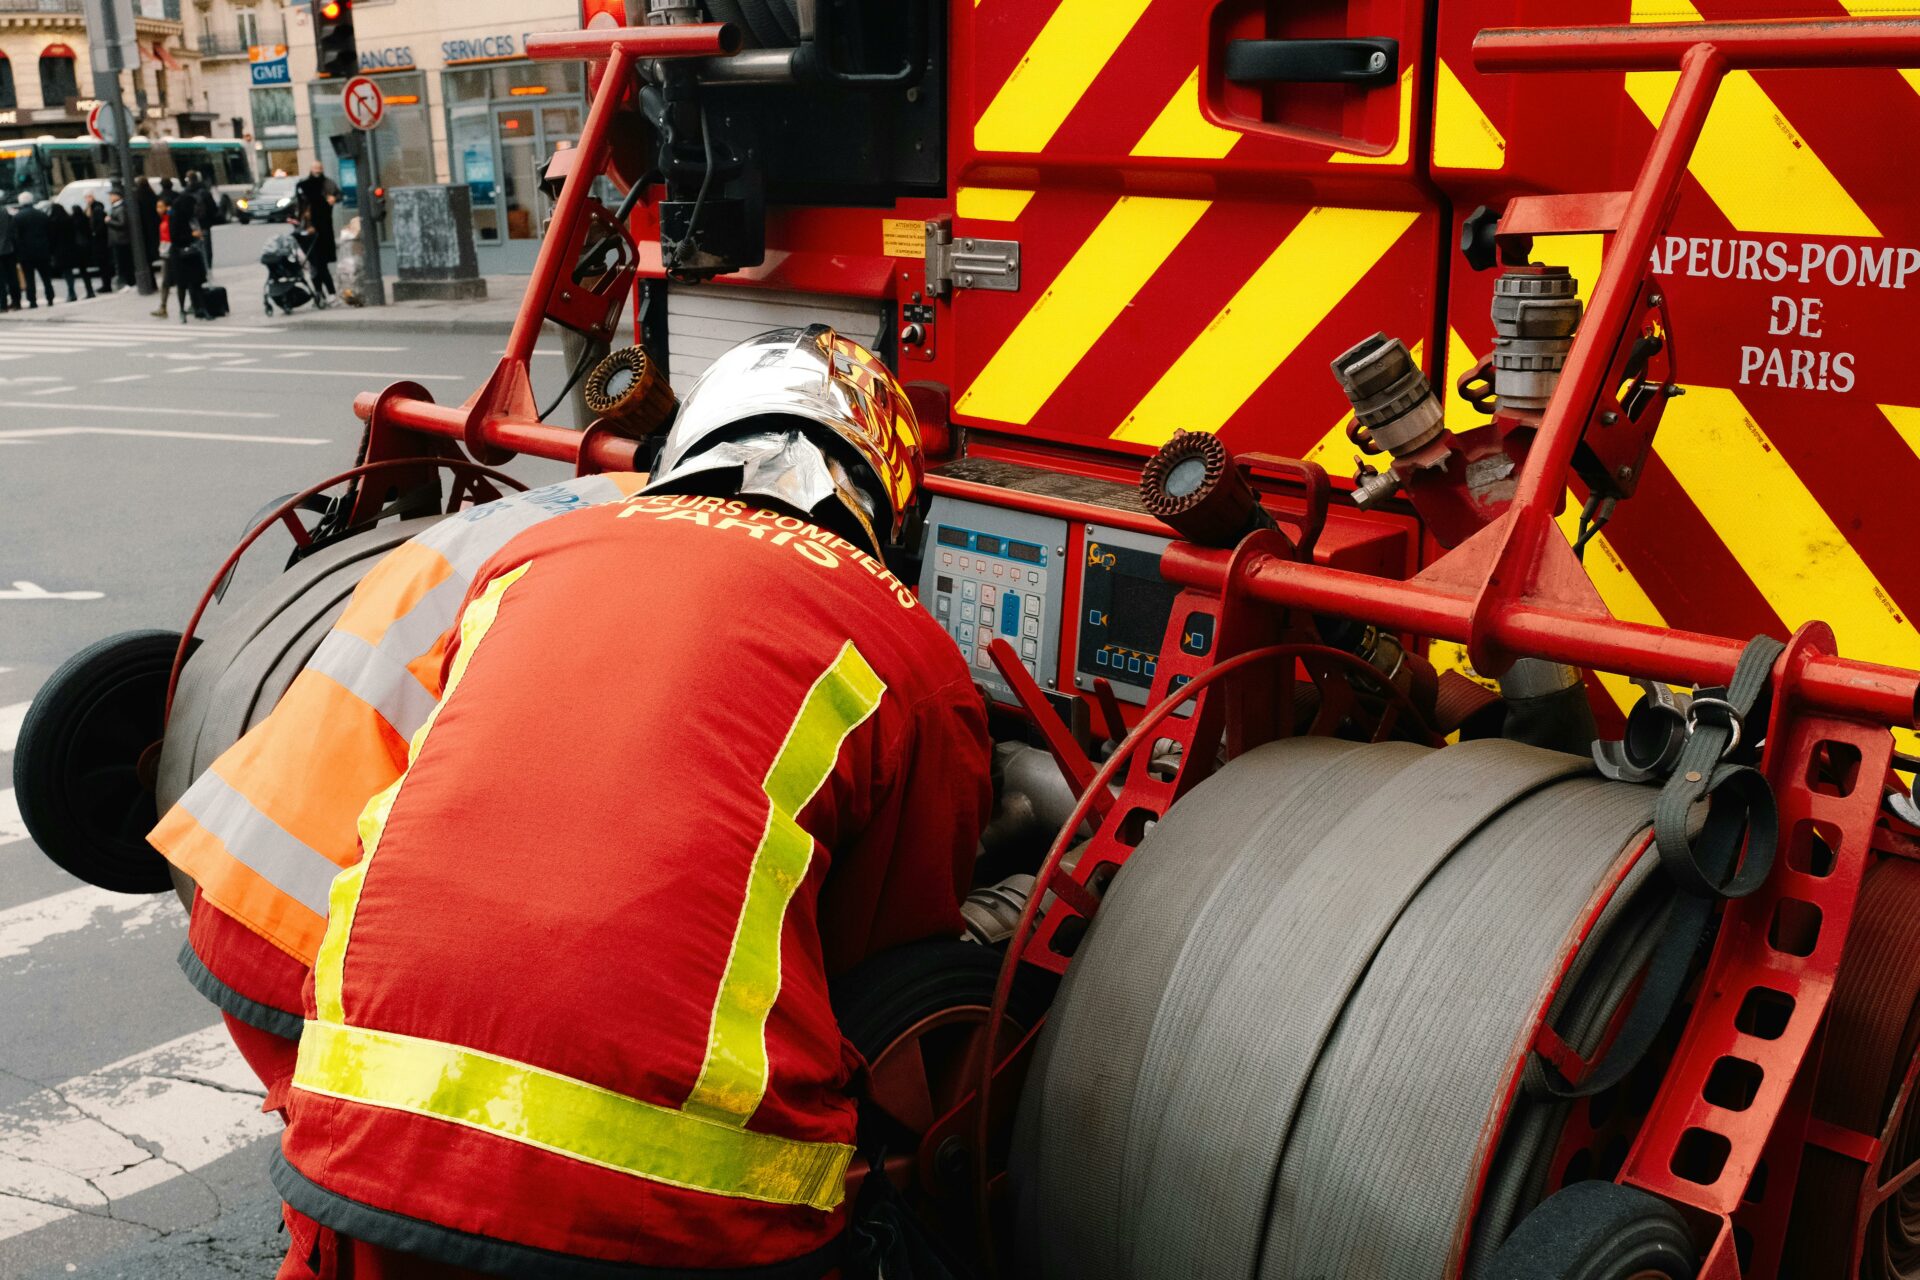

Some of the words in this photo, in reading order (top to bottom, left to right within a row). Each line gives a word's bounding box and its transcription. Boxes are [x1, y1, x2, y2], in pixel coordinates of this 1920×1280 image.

[441, 35, 513, 60] SERVICES
[253, 64, 286, 80] GMF
[1768, 296, 1823, 338] DE
[1739, 346, 1855, 393] PARIS
[604, 495, 748, 517] PEURS
[749, 508, 918, 609] POMPIERS
[616, 504, 843, 569] PARIS
